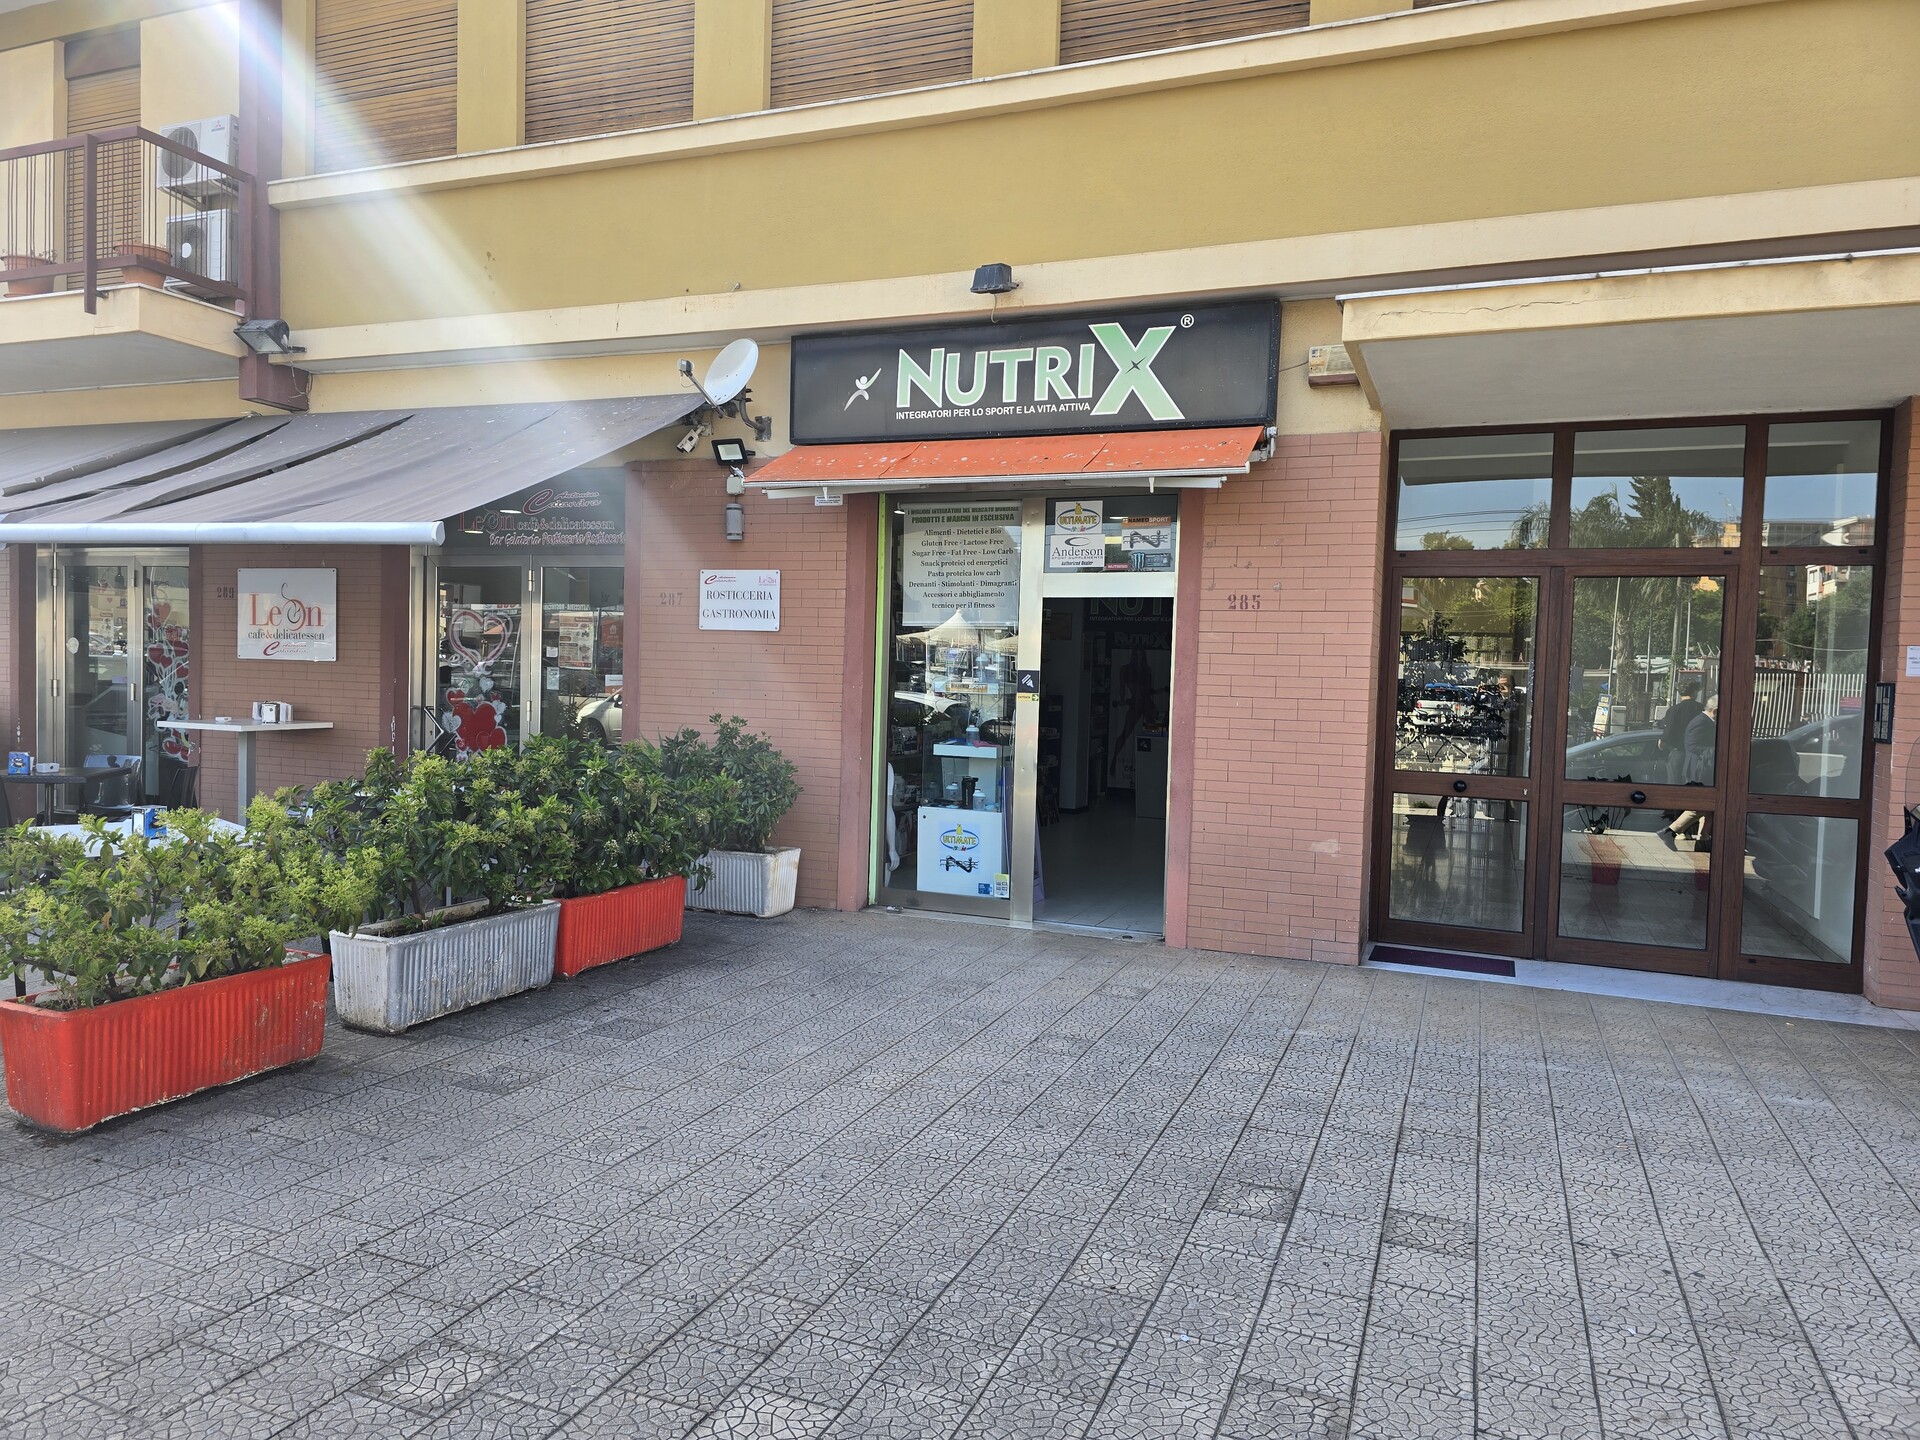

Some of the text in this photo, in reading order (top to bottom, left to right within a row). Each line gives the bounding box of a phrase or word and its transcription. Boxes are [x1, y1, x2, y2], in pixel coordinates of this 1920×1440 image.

[896, 322, 1185, 421] NUTRIX
[896, 410, 951, 420] INTEGRATORI
[953, 409, 970, 417] PER
[972, 408, 984, 416] LO
[985, 406, 1014, 416] SPORT
[1024, 405, 1035, 413] LA
[1037, 404, 1057, 413] VITA
[1059, 402, 1091, 411] ATTIVA
[912, 516, 940, 524] PRODOTTI
[980, 513, 1014, 521] ESCLUSIVA
[1059, 515, 1097, 525] ULTIMATE
[1052, 547, 1103, 557] Anderson
[975, 558, 1008, 566] energetici
[216, 587, 234, 598] 289
[706, 590, 773, 601] ROSTICCERIA
[959, 590, 1005, 598] abbigliamento
[1227, 594, 1261, 610] 285
[702, 609, 776, 619] GASTRONOMIA
[943, 835, 976, 845] ULTIMATE
